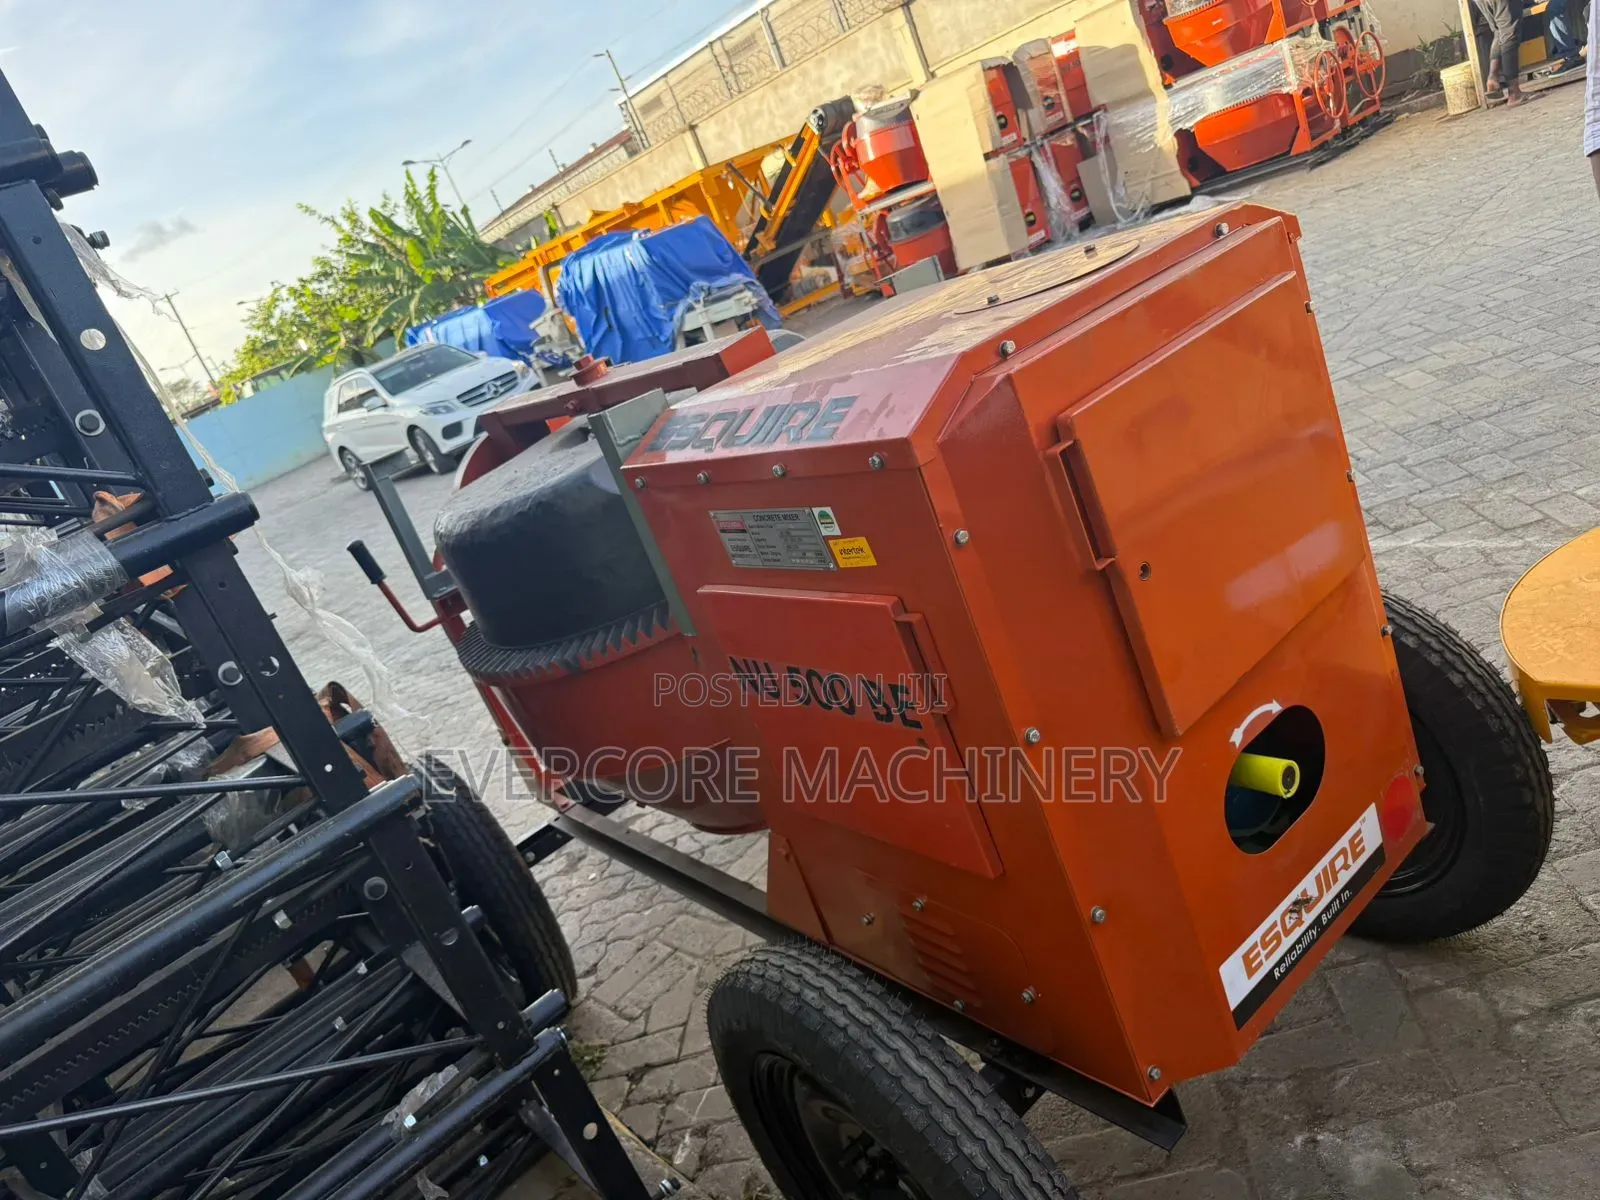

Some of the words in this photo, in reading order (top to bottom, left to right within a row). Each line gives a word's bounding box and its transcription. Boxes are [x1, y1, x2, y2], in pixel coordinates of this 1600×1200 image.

[1241, 828, 1367, 981] ESQUIRE
[1321, 900, 1341, 925] Built
[1341, 888, 1353, 904] In.
